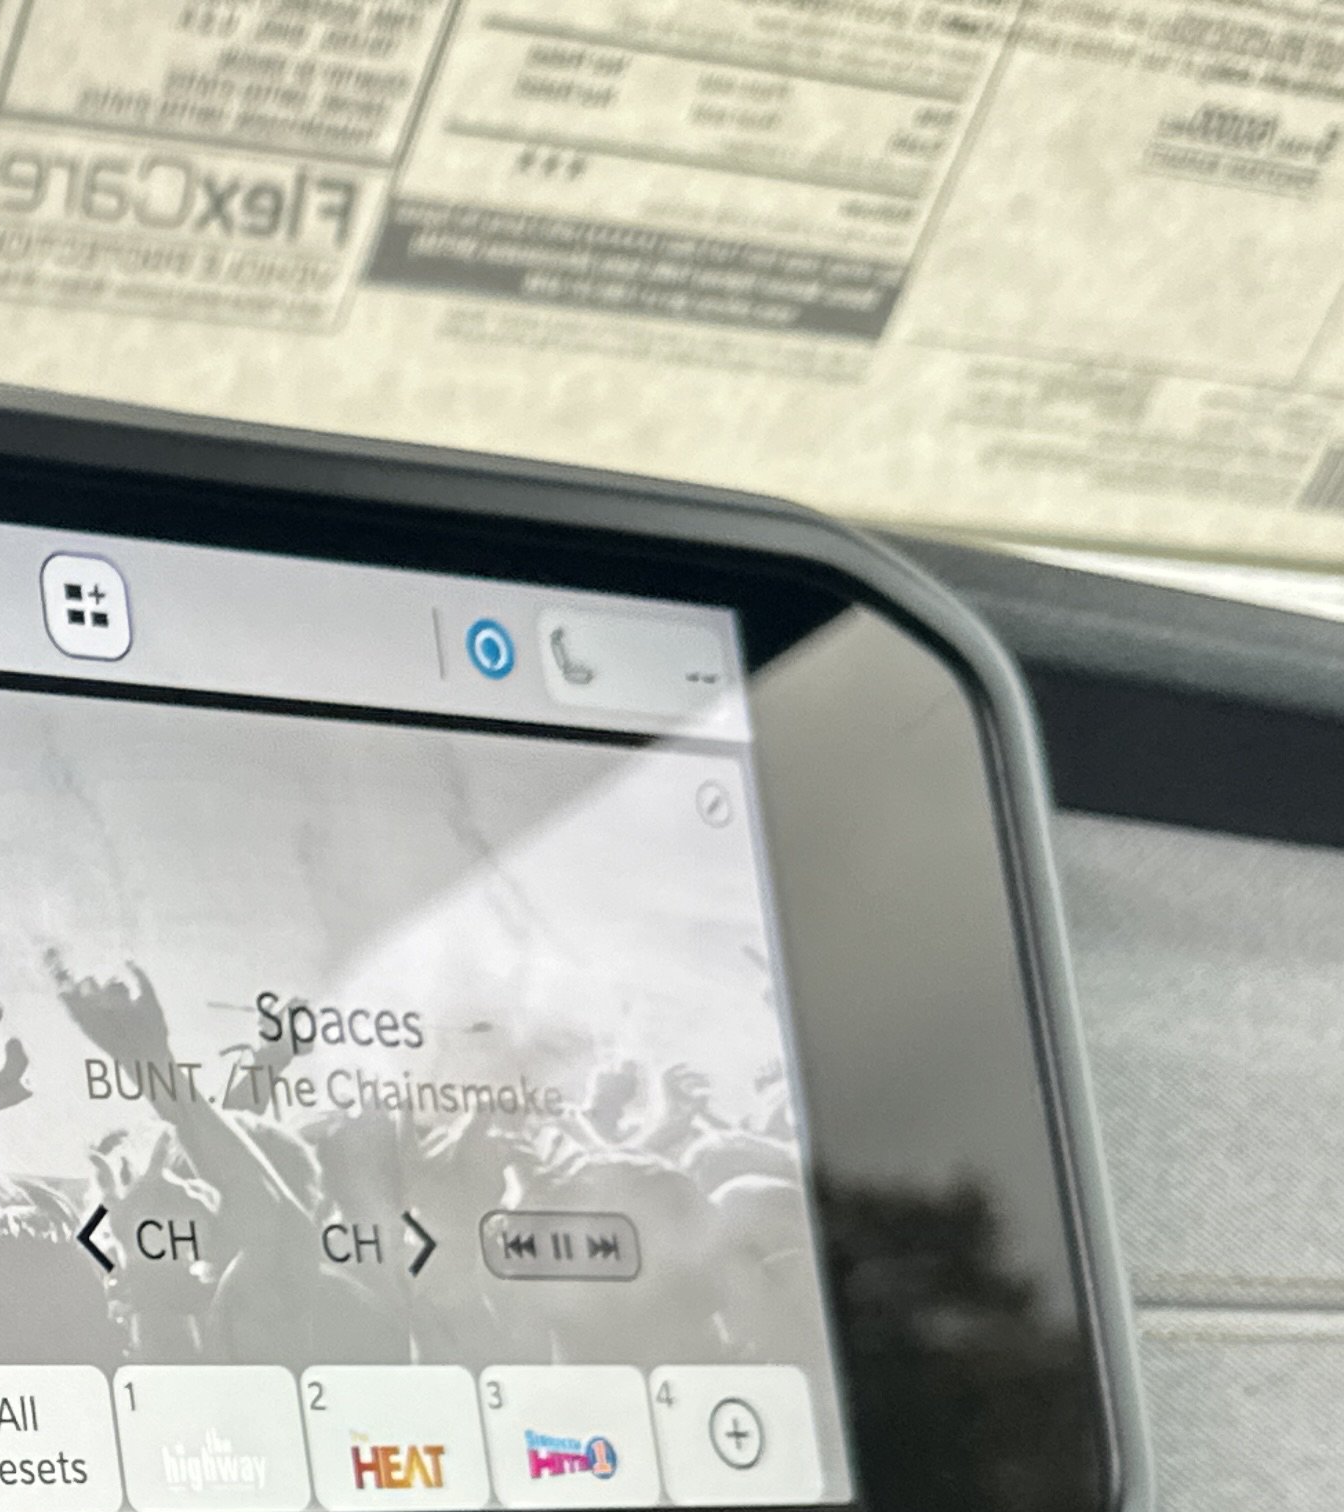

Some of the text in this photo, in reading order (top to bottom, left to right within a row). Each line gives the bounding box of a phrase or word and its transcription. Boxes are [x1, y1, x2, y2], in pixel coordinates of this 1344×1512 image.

[255, 991, 424, 1054] Spaces
[135, 1219, 201, 1262] CH
[321, 1223, 384, 1265] CH
[123, 1381, 137, 1412] 1
[306, 1381, 328, 1411] 2
[485, 1380, 505, 1410] 3
[655, 1380, 674, 1408] 4
[161, 1445, 266, 1492] highway
[350, 1444, 445, 1490] HEAT
